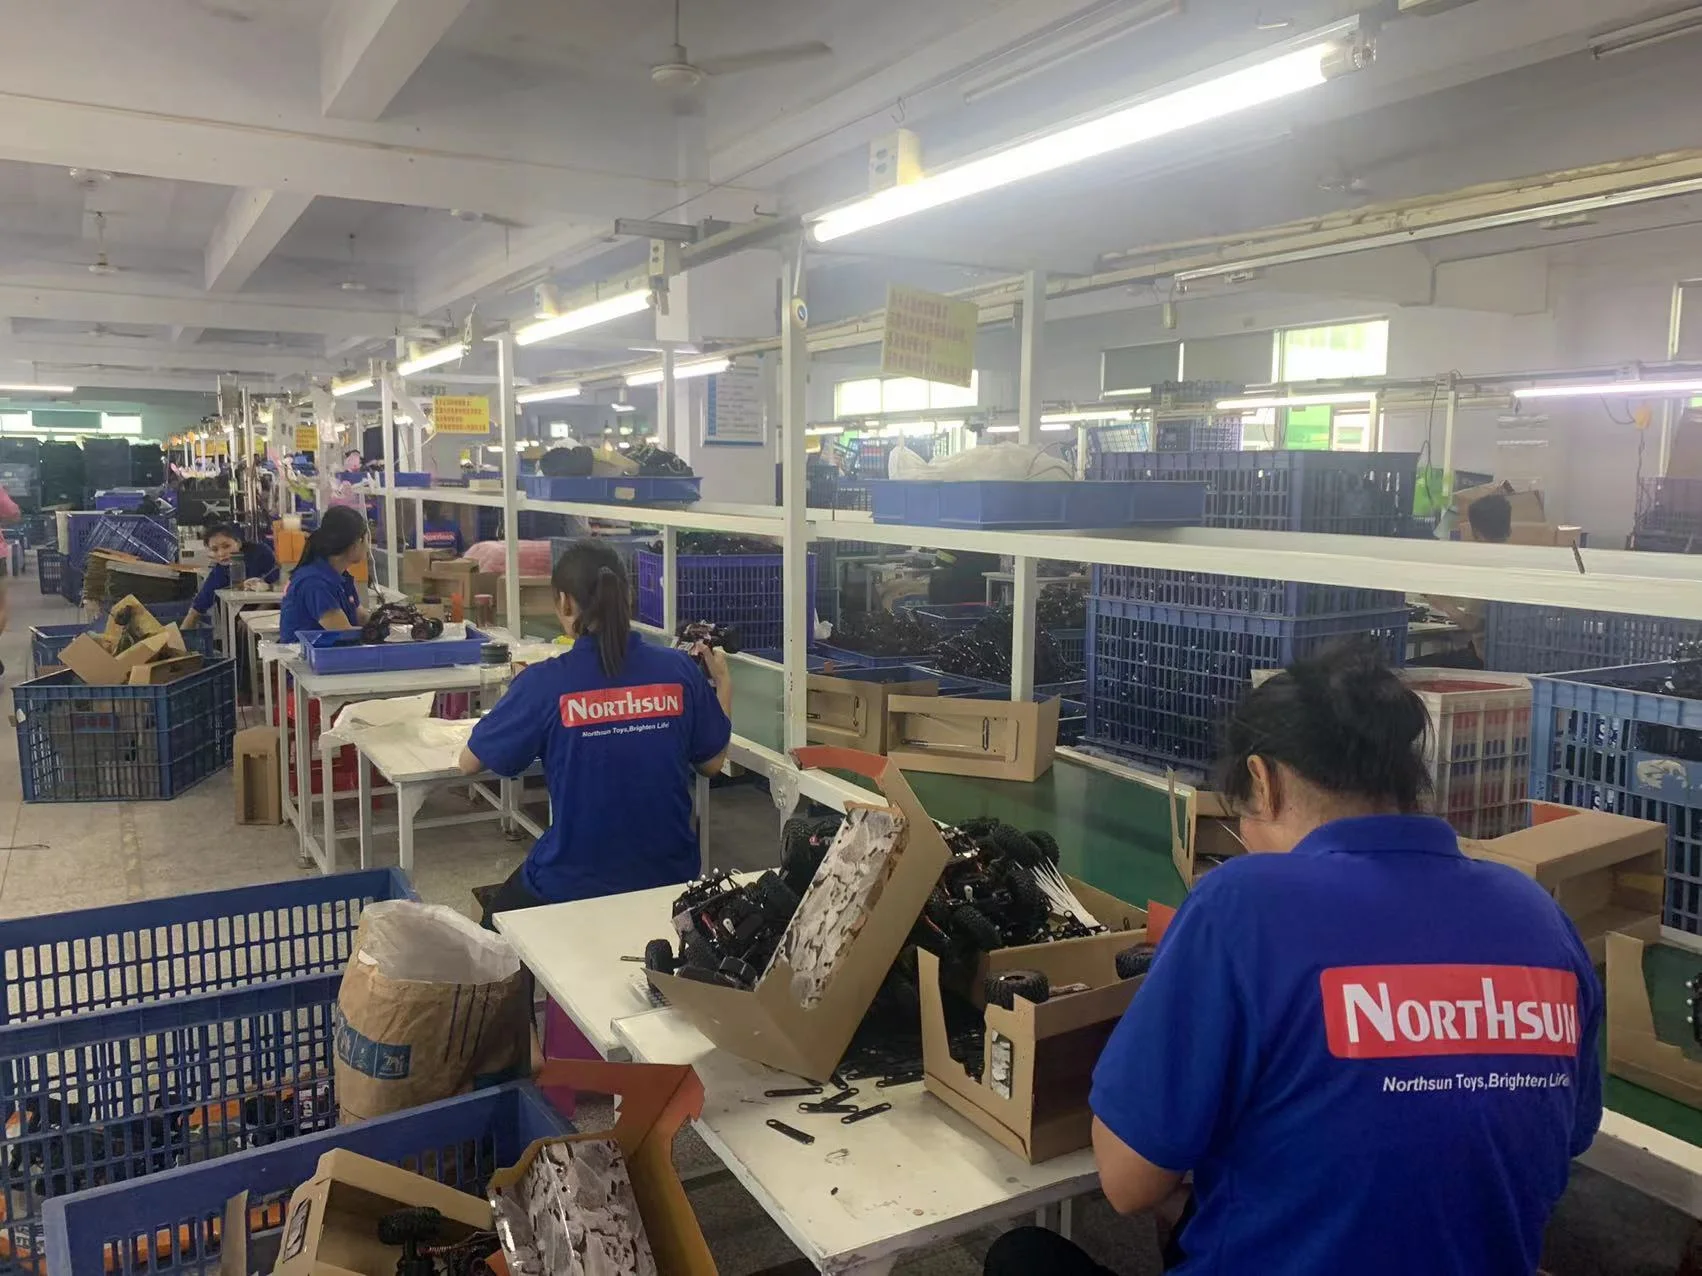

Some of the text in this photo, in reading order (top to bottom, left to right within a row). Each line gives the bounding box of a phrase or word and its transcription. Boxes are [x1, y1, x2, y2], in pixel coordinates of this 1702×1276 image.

[567, 692, 679, 722] NORTHSUN
[582, 729, 611, 737] Northsun
[657, 722, 669, 730] Life
[1383, 1075, 1453, 1092] Northsun
